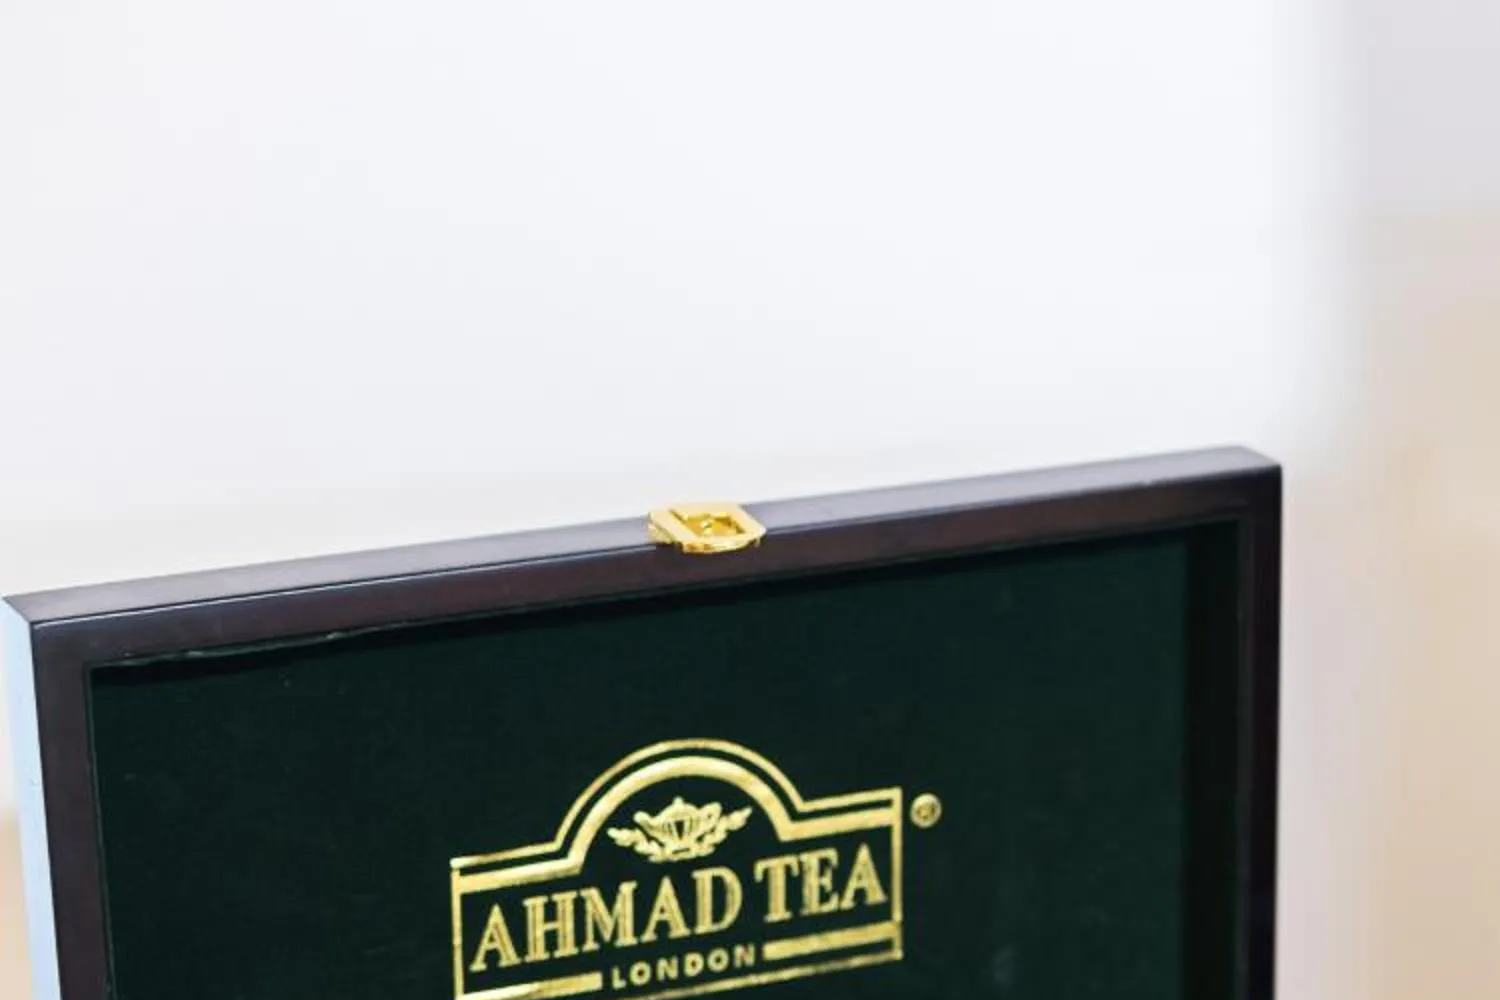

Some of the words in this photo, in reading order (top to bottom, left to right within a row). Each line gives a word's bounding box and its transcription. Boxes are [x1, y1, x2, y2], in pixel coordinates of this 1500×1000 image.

[469, 866, 742, 973] AHMAD
[754, 843, 888, 923] TEA
[611, 944, 756, 989] LONDON
